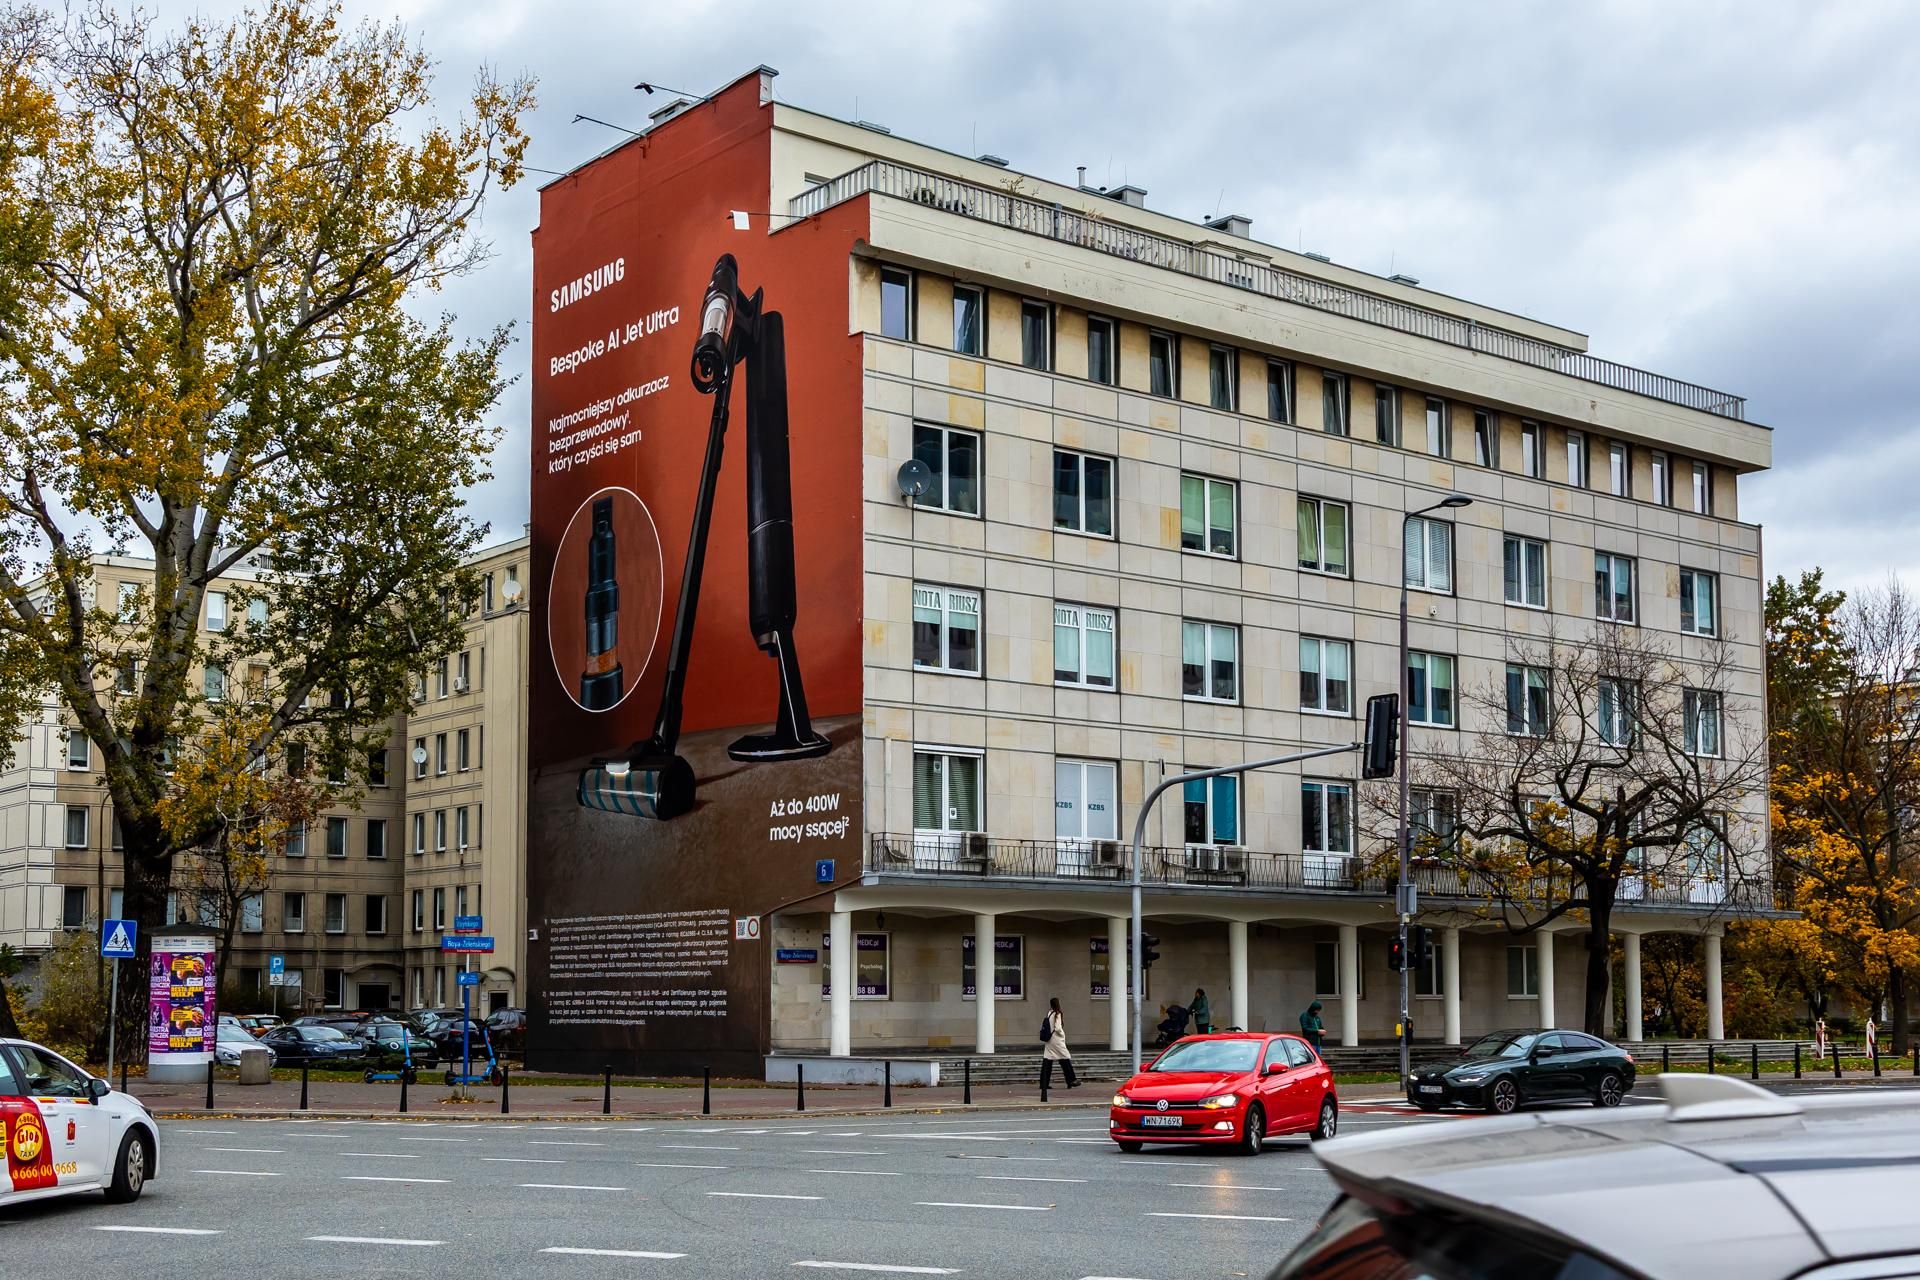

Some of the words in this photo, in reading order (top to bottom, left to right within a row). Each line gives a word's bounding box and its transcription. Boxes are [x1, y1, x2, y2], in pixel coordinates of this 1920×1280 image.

[550, 258, 624, 313] SAMSUNG
[550, 340, 604, 376] Bespoke
[607, 328, 620, 352] AI
[622, 318, 644, 345] Jet
[646, 306, 679, 335] Ultra
[549, 397, 616, 434] Najmocniejszy
[616, 375, 670, 406] odkurzacz
[548, 454, 573, 474] który
[574, 440, 604, 464] czyści
[604, 436, 619, 454] się
[620, 429, 642, 448] sam
[914, 588, 941, 608] NOTA
[949, 594, 978, 614] RIUSZ
[1054, 608, 1079, 626] NOTA
[1086, 612, 1112, 630] RIUSZ
[770, 799, 785, 818] Aż
[787, 798, 804, 815] do
[806, 792, 840, 812] 400W
[770, 824, 804, 844] mocy
[821, 864, 826, 877] 6
[17, 1128, 39, 1144] Glob
[20, 1165, 38, 1179] 666
[40, 1164, 52, 1176] 00
[55, 1161, 77, 1175] 9668
